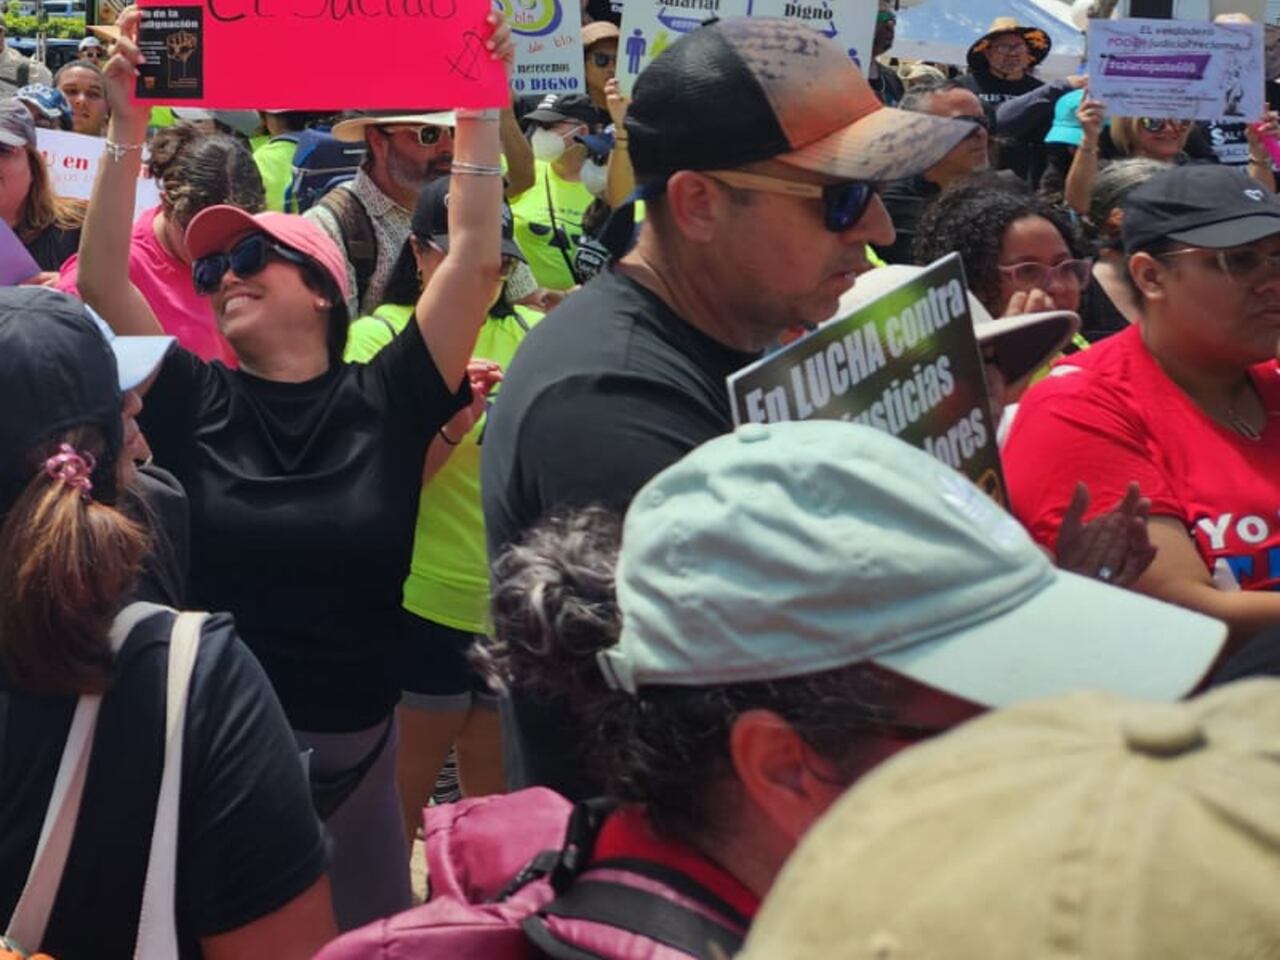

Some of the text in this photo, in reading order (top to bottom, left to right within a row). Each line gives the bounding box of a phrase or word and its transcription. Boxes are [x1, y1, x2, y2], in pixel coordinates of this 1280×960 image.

[785, 3, 833, 20] Digno
[530, 76, 578, 91] DIGNO
[63, 156, 90, 171] en
[745, 278, 966, 425] En LUCHA contra
[1197, 513, 1269, 550] YO
